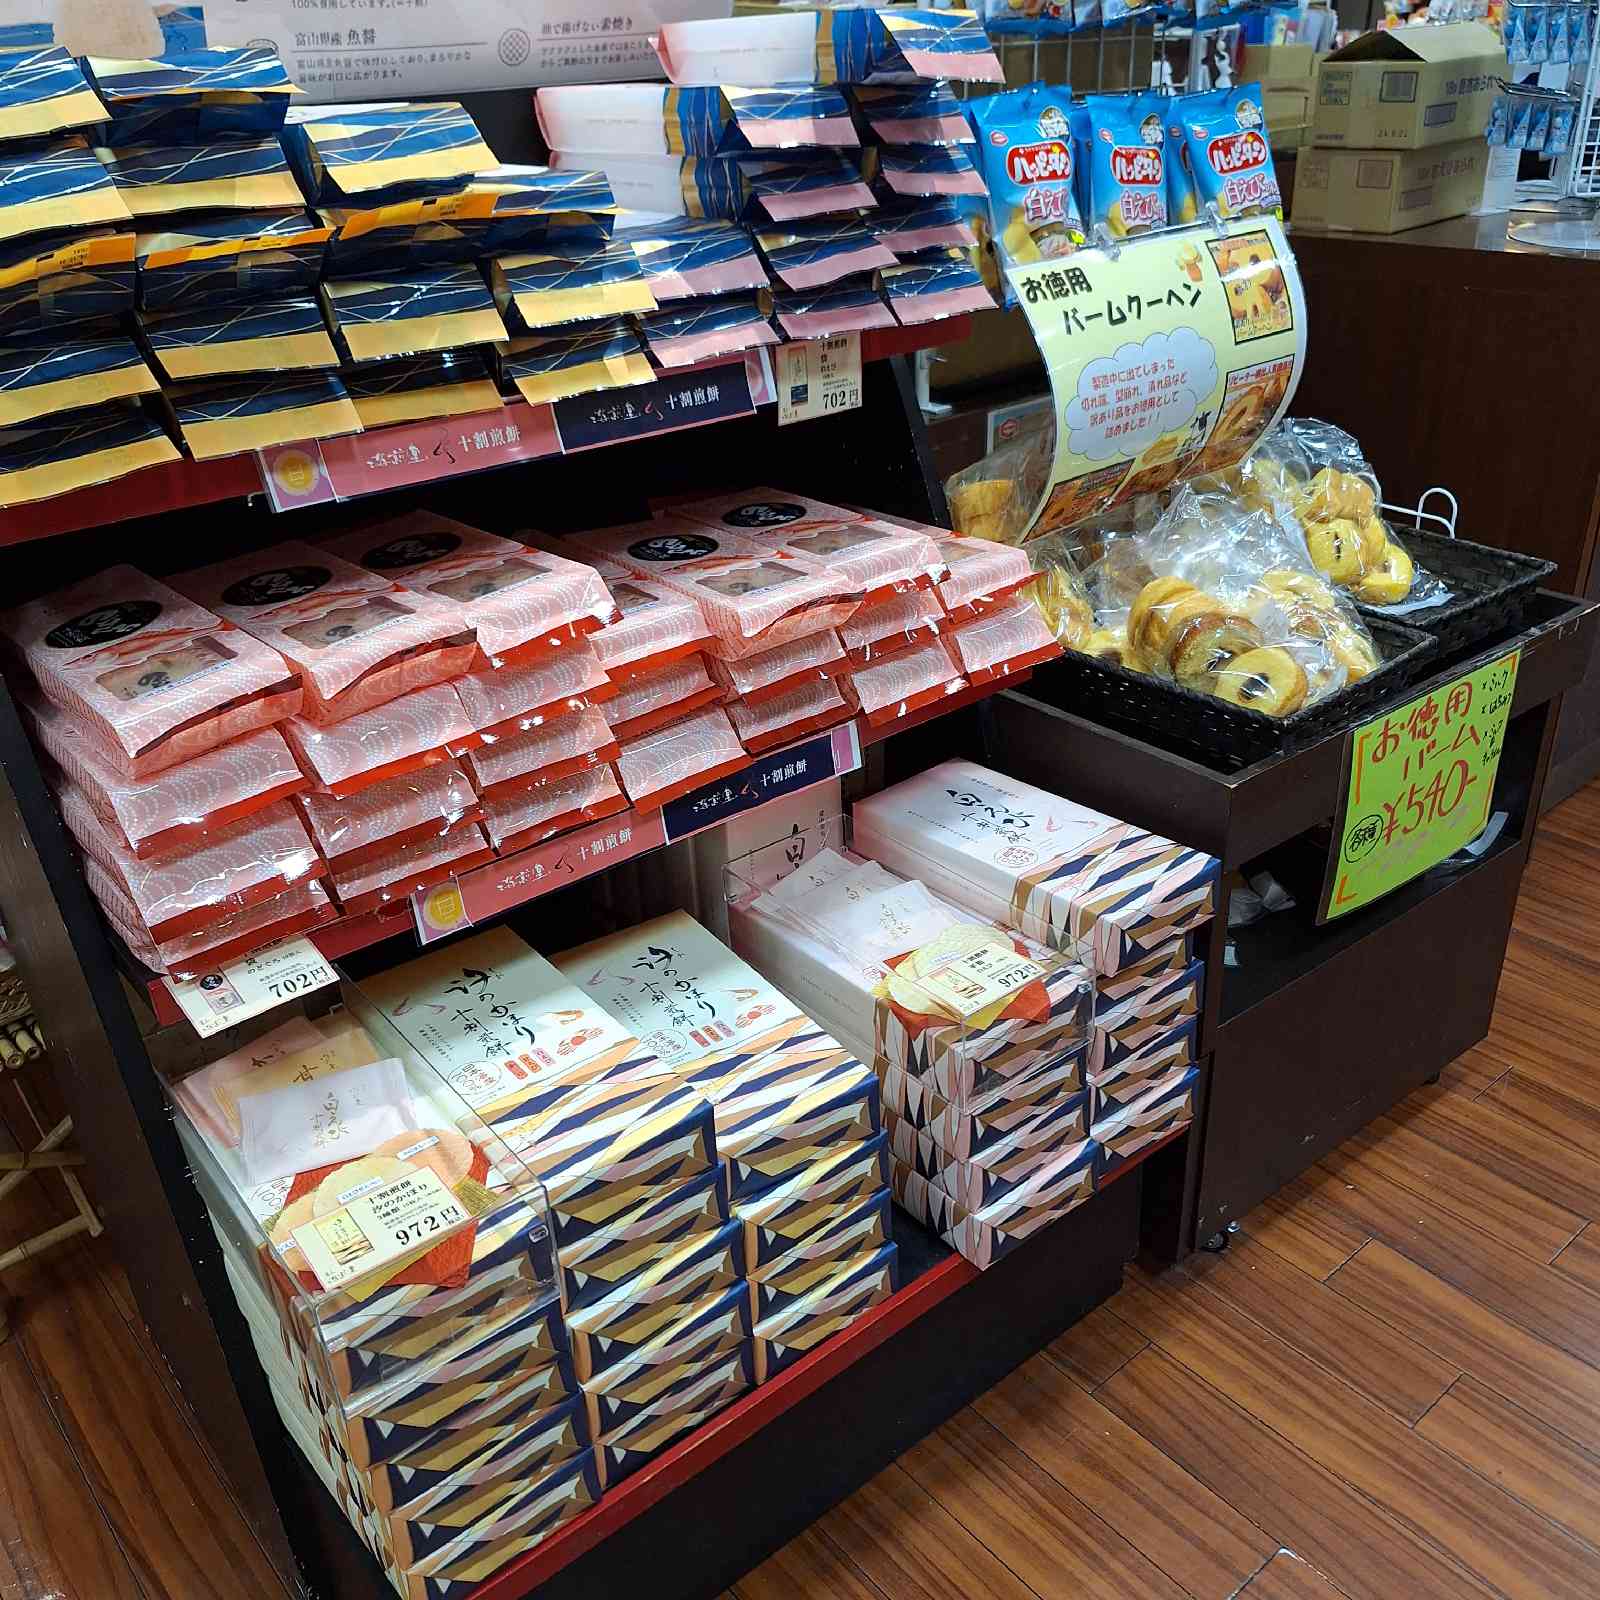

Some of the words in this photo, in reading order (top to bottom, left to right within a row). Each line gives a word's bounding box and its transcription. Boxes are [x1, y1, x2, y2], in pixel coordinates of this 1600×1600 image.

[1021, 266, 1093, 304] お徳用
[1063, 282, 1202, 336] バームクーヘン
[822, 388, 859, 411] 702円
[458, 424, 520, 452] 十割煎餅
[1371, 681, 1473, 764] お徳用
[1402, 723, 1481, 781] バーム
[758, 757, 809, 788] 十割煎餅
[575, 827, 634, 862] 十割煎餅
[268, 965, 329, 999] 702円
[998, 964, 1039, 989] 972円
[394, 1203, 461, 1247] 972円
